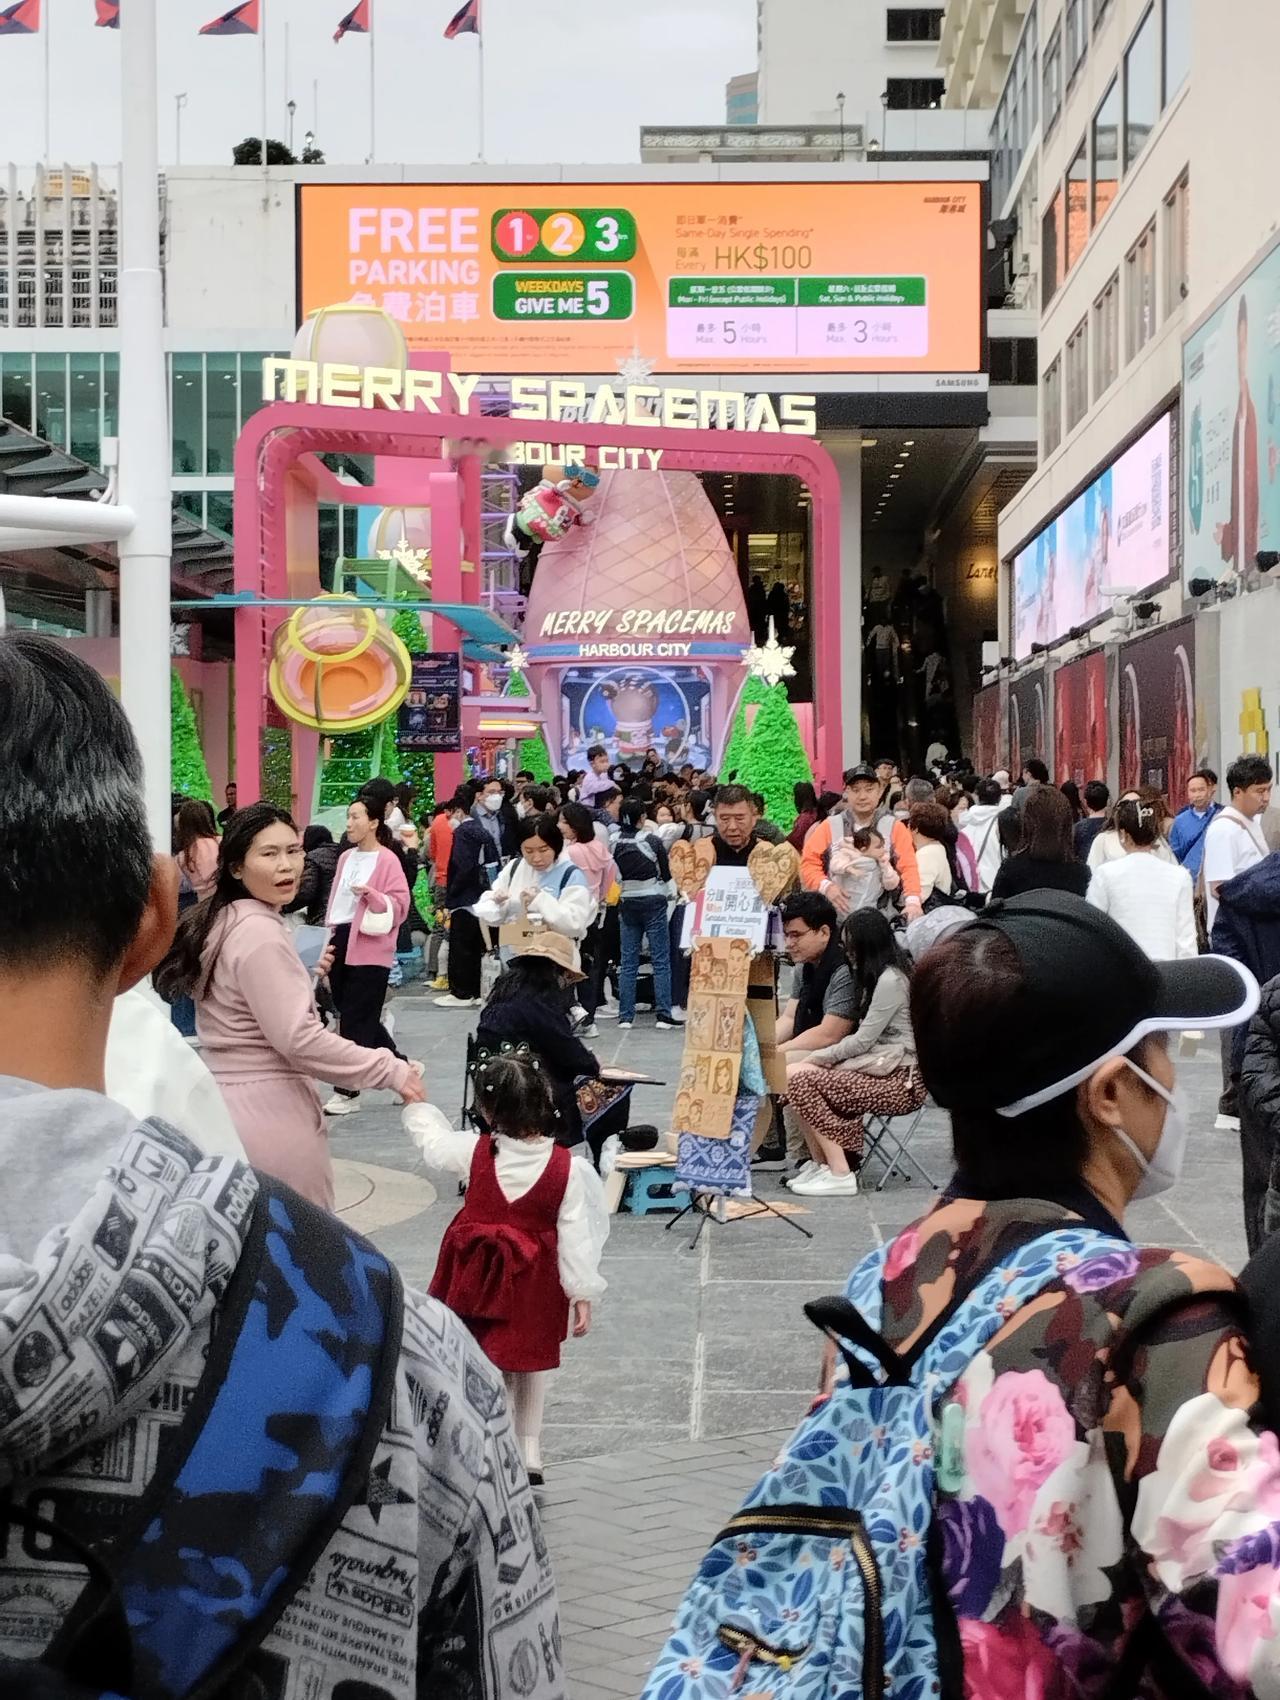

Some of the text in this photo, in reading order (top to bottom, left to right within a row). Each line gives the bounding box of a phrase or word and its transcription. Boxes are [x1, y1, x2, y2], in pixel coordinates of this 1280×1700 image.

[348, 207, 480, 253] FREE
[509, 217, 523, 252] 1
[551, 217, 574, 252] 2
[595, 217, 619, 252] 3
[729, 228, 760, 240] Single
[675, 259, 706, 271] Every
[715, 243, 812, 271] HK$100
[349, 260, 480, 285] PARKING
[515, 280, 584, 293] WEEKDAYS
[515, 280, 611, 315] GIVE ME 5
[723, 320, 737, 344] 5
[741, 335, 767, 344] Hours
[853, 320, 868, 344] 3
[871, 334, 898, 343] Hours
[936, 379, 979, 387] SAMSUNG
[262, 357, 481, 417] MERRY
[509, 378, 817, 436] SPACEMAS
[598, 446, 664, 471] CITY
[539, 608, 736, 637] MERRY SPACEMAS
[579, 643, 692, 657] HARBOUR CITY
[59, 1258, 95, 1313] adidas
[69, 1272, 113, 1337] GAZELLE
[349, 1657, 389, 1676] BRAND
